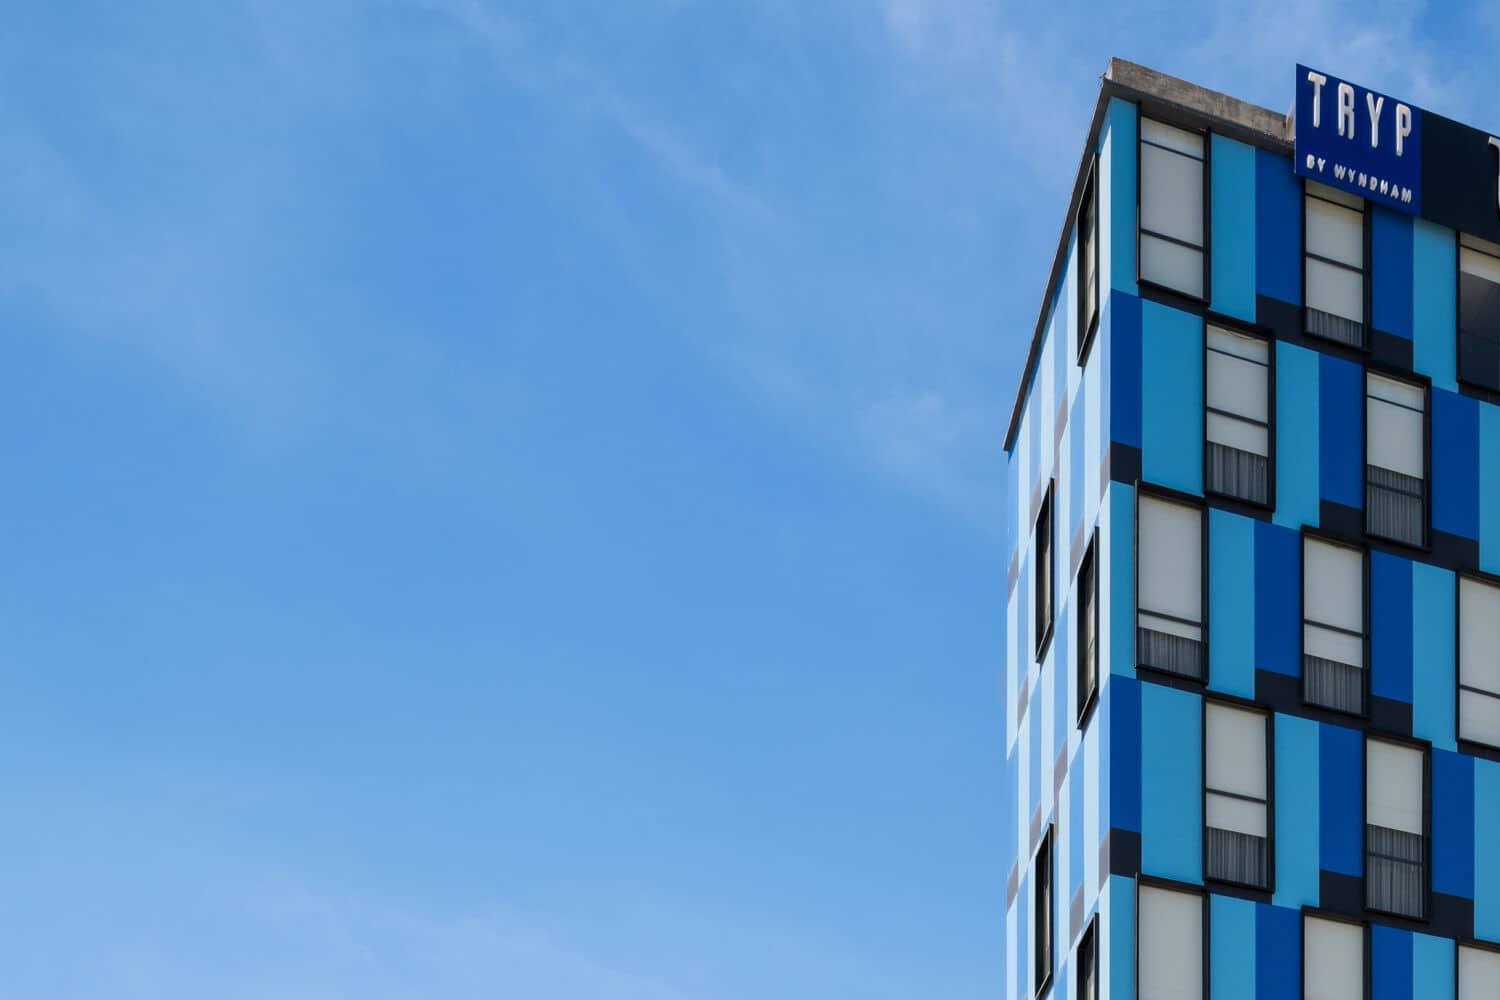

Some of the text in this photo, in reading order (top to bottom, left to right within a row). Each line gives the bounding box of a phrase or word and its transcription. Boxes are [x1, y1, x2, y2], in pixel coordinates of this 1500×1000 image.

[1307, 71, 1412, 157] TRYP
[1306, 154, 1412, 204] BY WYNDHAM
